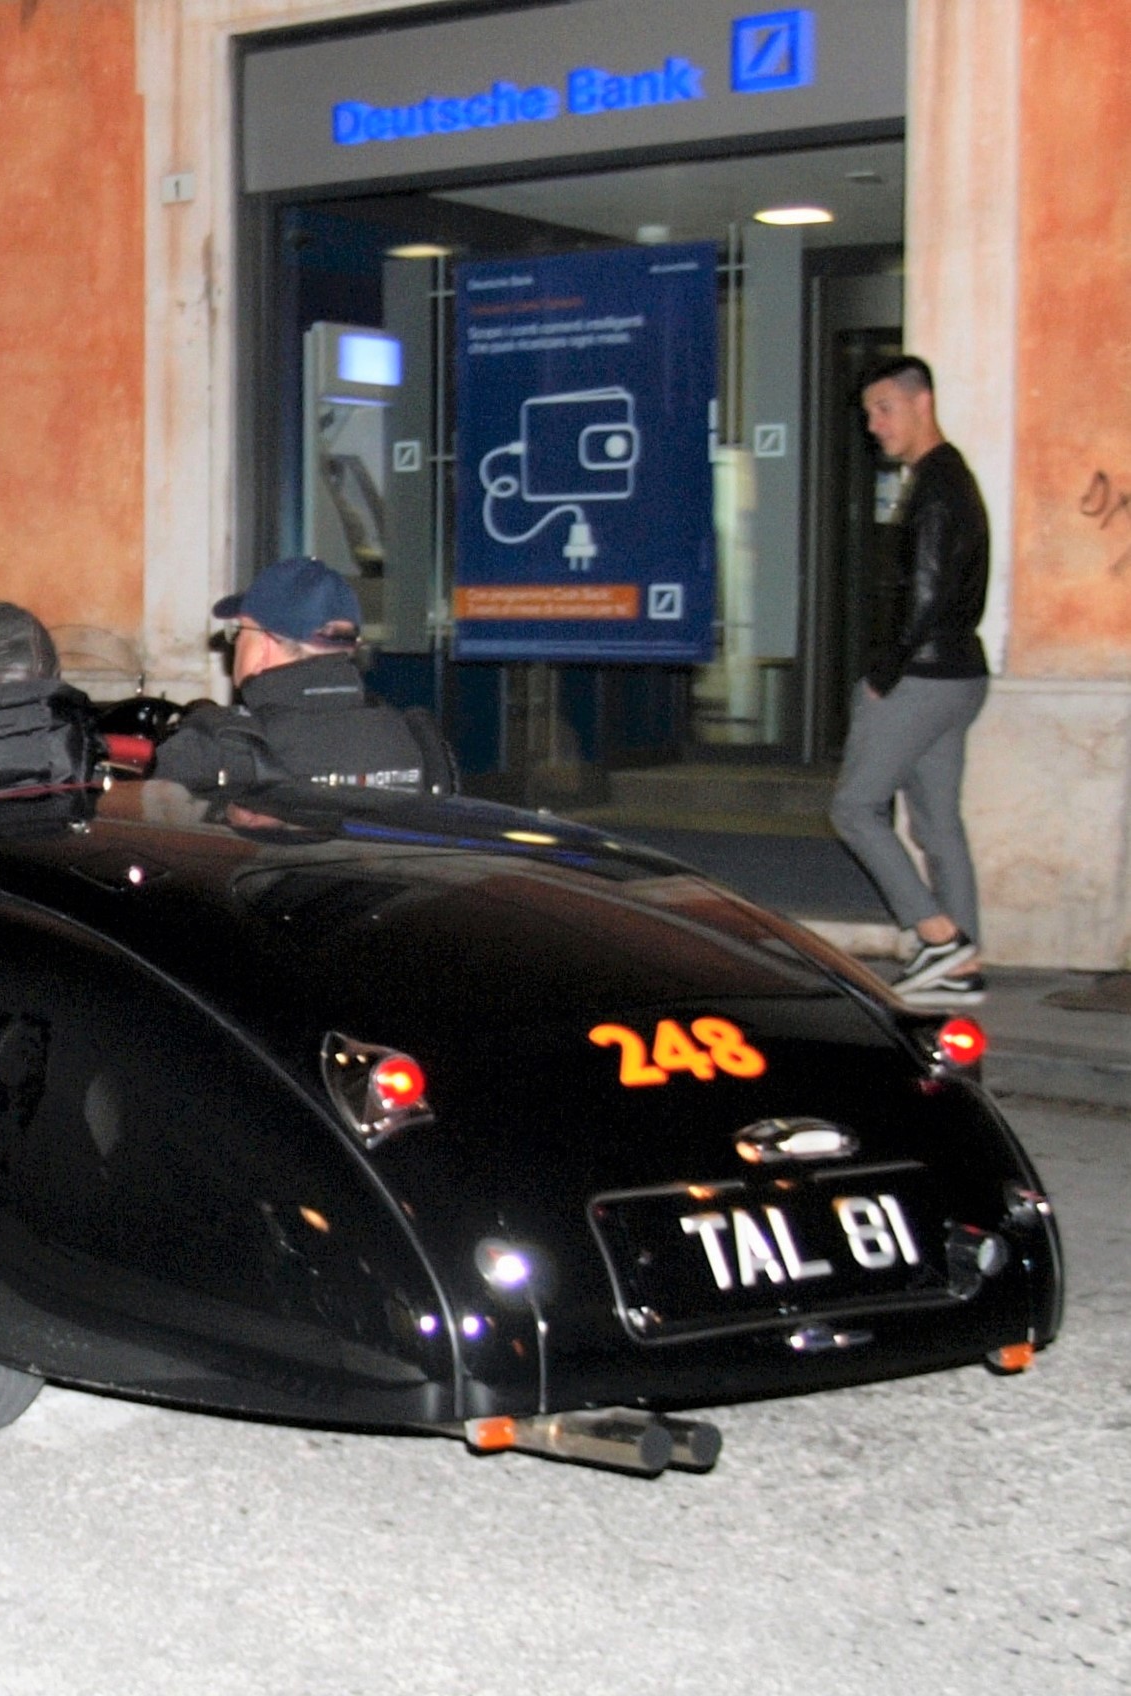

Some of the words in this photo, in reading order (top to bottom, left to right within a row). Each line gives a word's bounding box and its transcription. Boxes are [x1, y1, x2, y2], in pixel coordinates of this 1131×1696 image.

[332, 82, 560, 146] Deutsche
[567, 55, 706, 116] Bank
[587, 1015, 768, 1088] 248
[678, 1205, 833, 1291] TAL
[831, 1193, 919, 1271] 81
